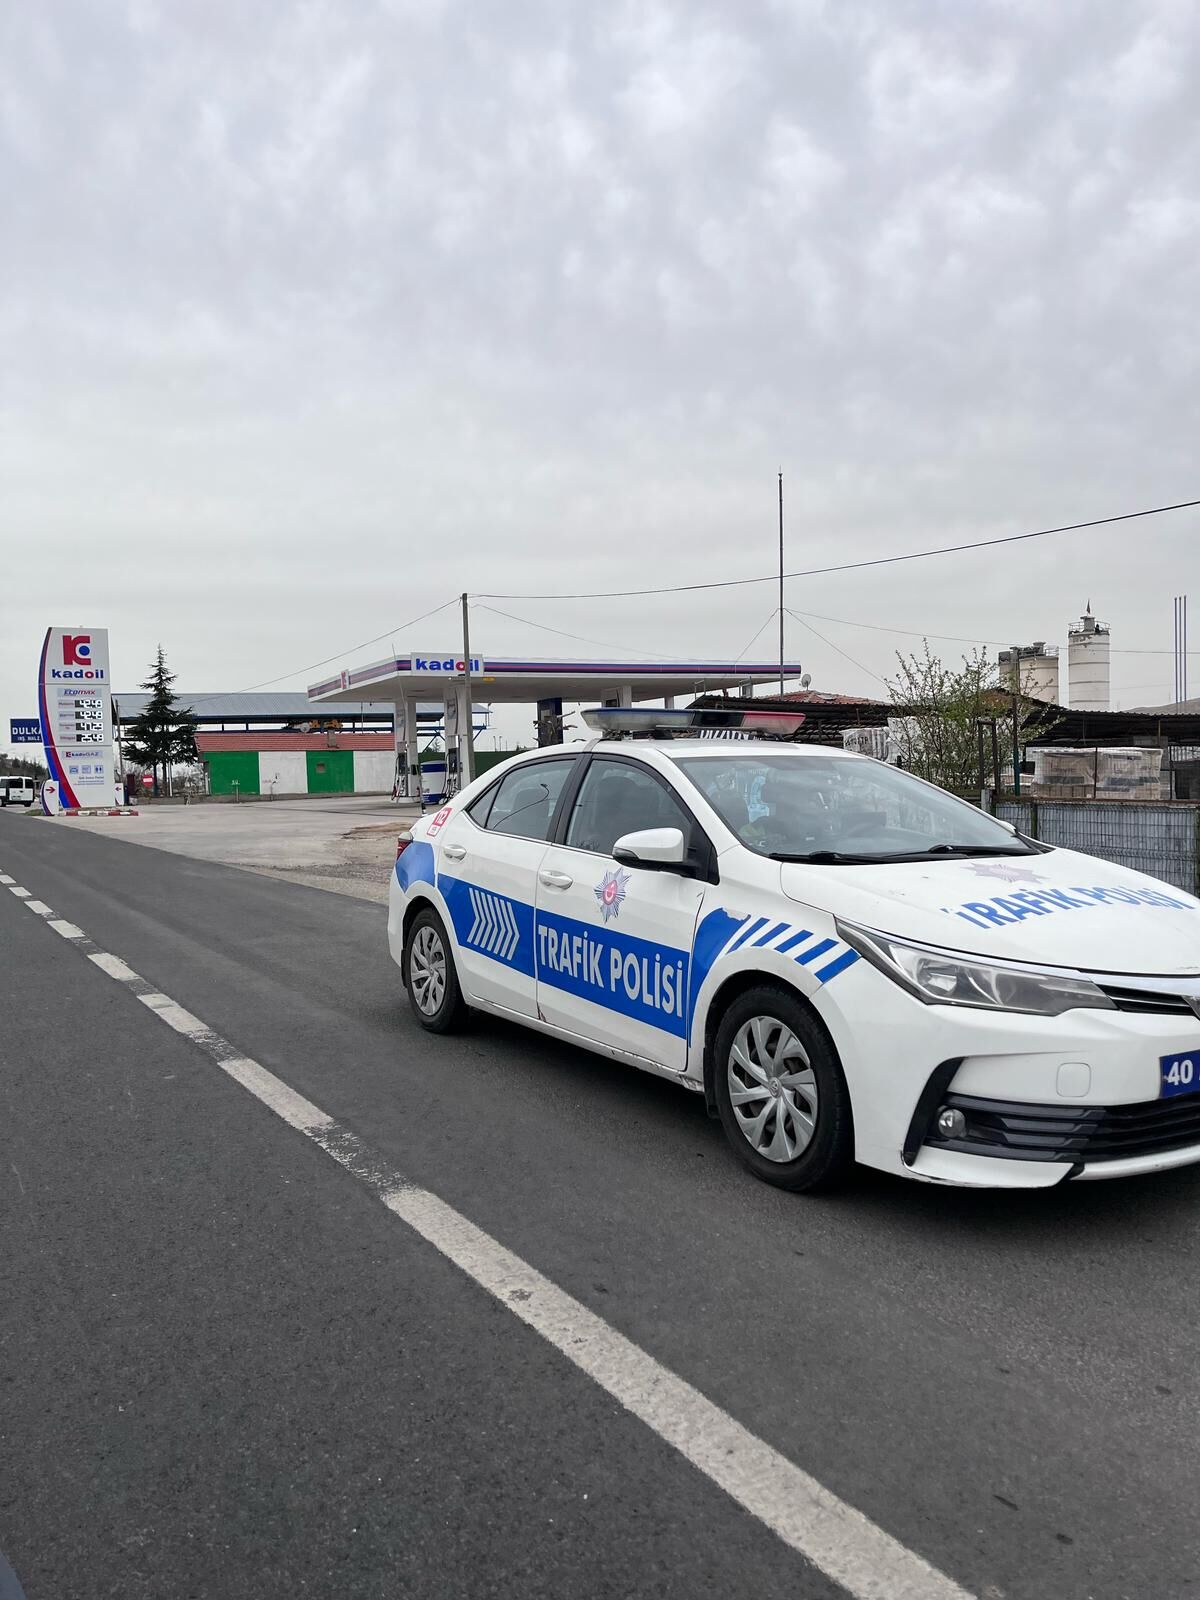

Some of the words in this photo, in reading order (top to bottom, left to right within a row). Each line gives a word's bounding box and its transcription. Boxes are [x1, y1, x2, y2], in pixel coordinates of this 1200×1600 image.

[52, 669, 104, 679] kadoil
[416, 658, 479, 672] kadoil
[1068, 885, 1196, 910] POLİSİ
[538, 924, 604, 989] TRAFİK
[609, 947, 683, 1018] POLİSİ
[1167, 1059, 1194, 1086] 40
